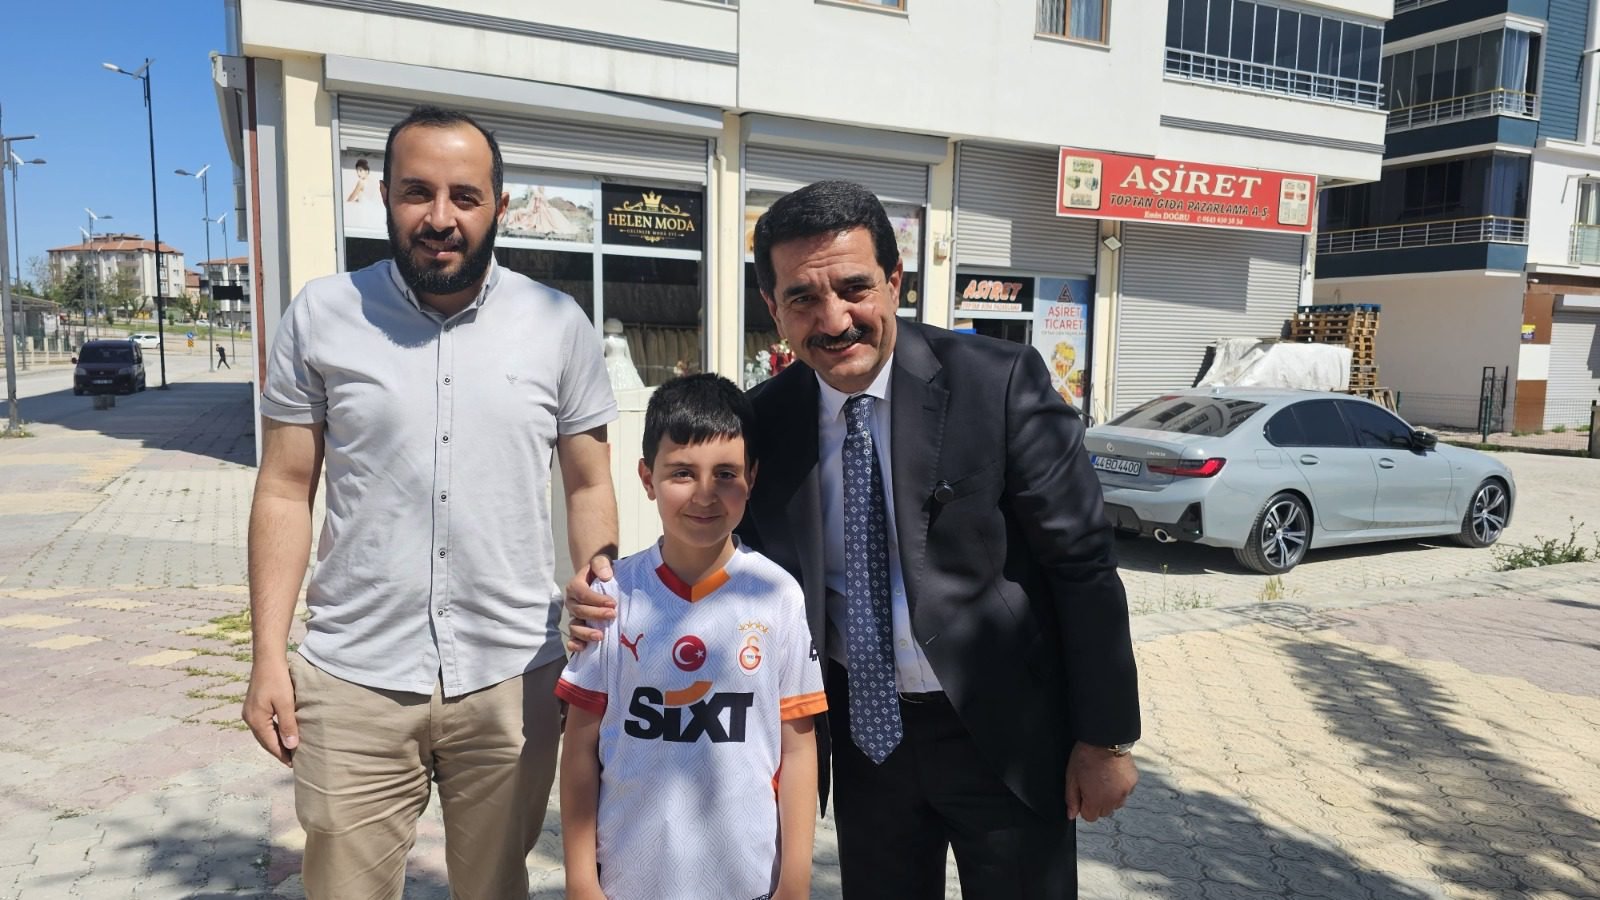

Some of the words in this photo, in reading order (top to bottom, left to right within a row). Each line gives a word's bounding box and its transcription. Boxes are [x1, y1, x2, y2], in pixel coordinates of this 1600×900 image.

[1120, 164, 1262, 198] AŞİRET
[1111, 195, 1153, 208] TOPTAN
[1157, 199, 1184, 211] GIDA
[1187, 201, 1249, 216] PAZARLAMA
[608, 213, 652, 228] HELEN
[655, 216, 695, 232] MODA
